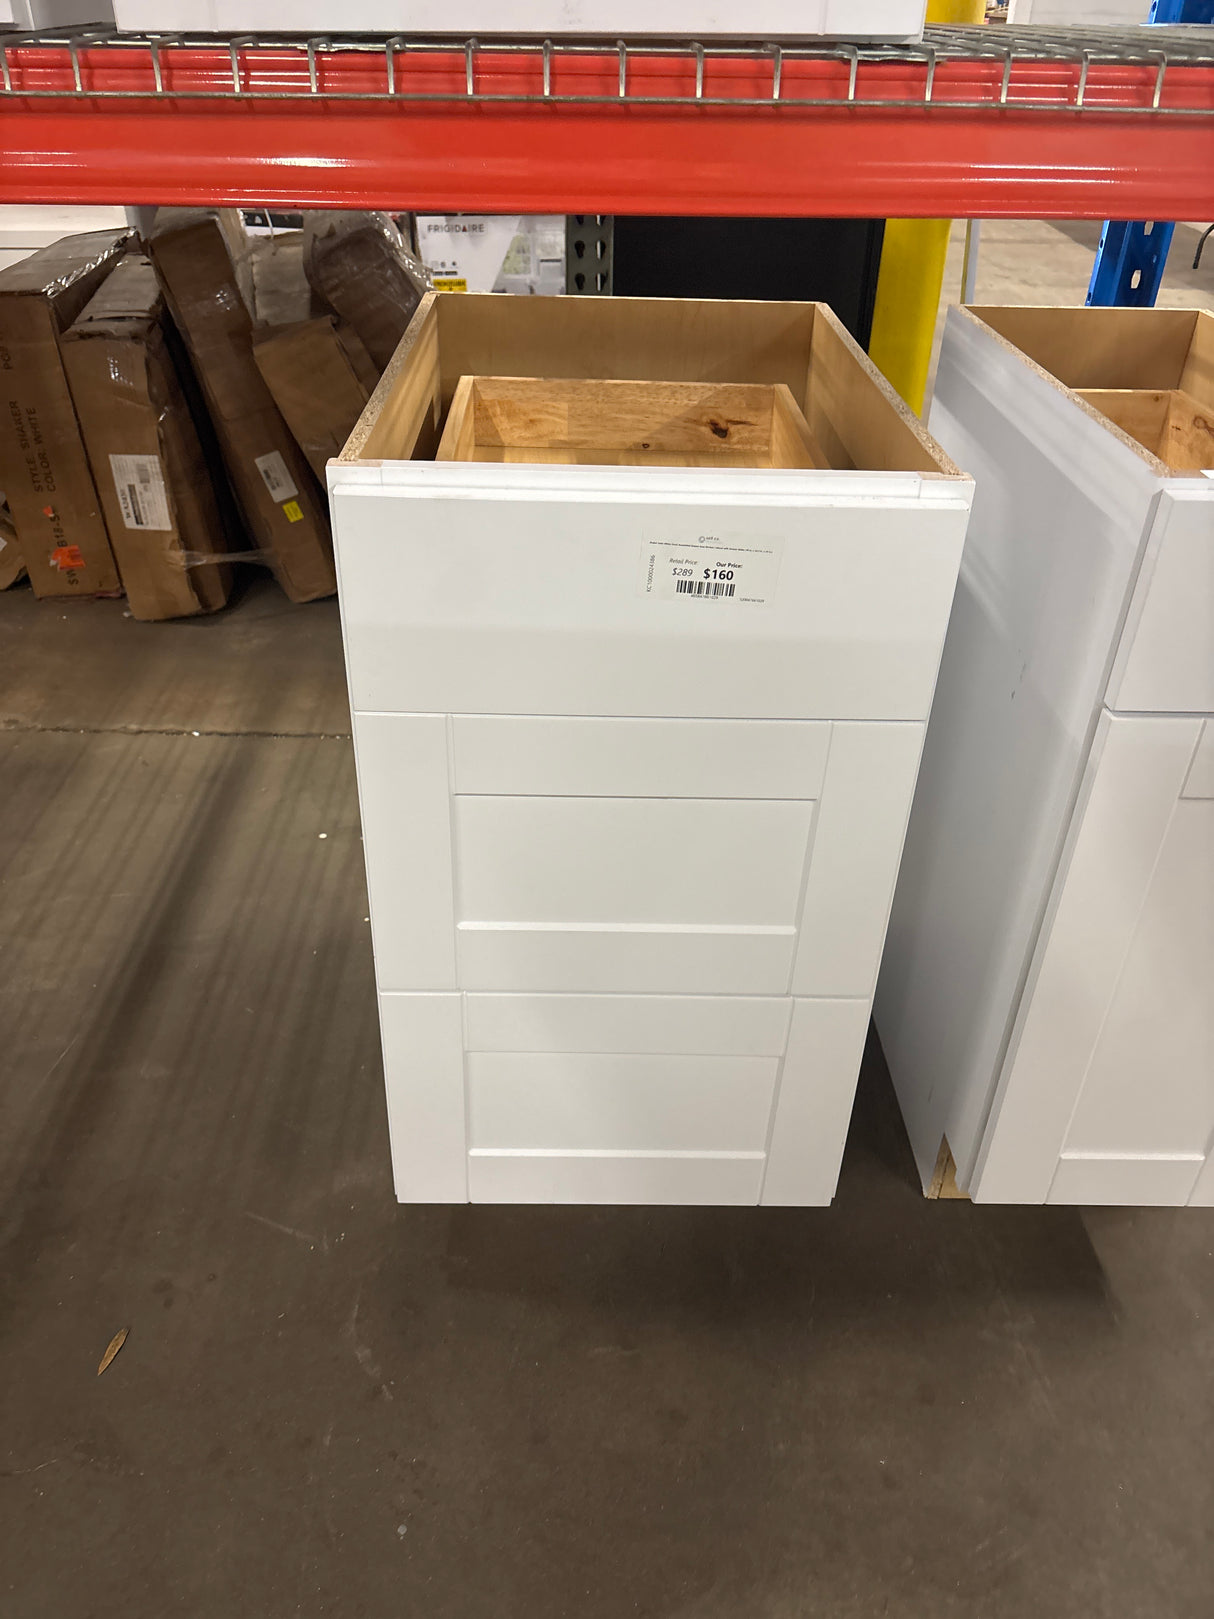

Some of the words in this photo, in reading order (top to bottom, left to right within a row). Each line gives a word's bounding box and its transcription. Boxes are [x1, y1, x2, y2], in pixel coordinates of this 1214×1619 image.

[427, 224, 485, 233] FRIGIDAIRE
[9, 400, 30, 450] SHAKER
[26, 407, 42, 444] WHITE
[672, 567, 693, 577] $289
[703, 567, 734, 581] $160
